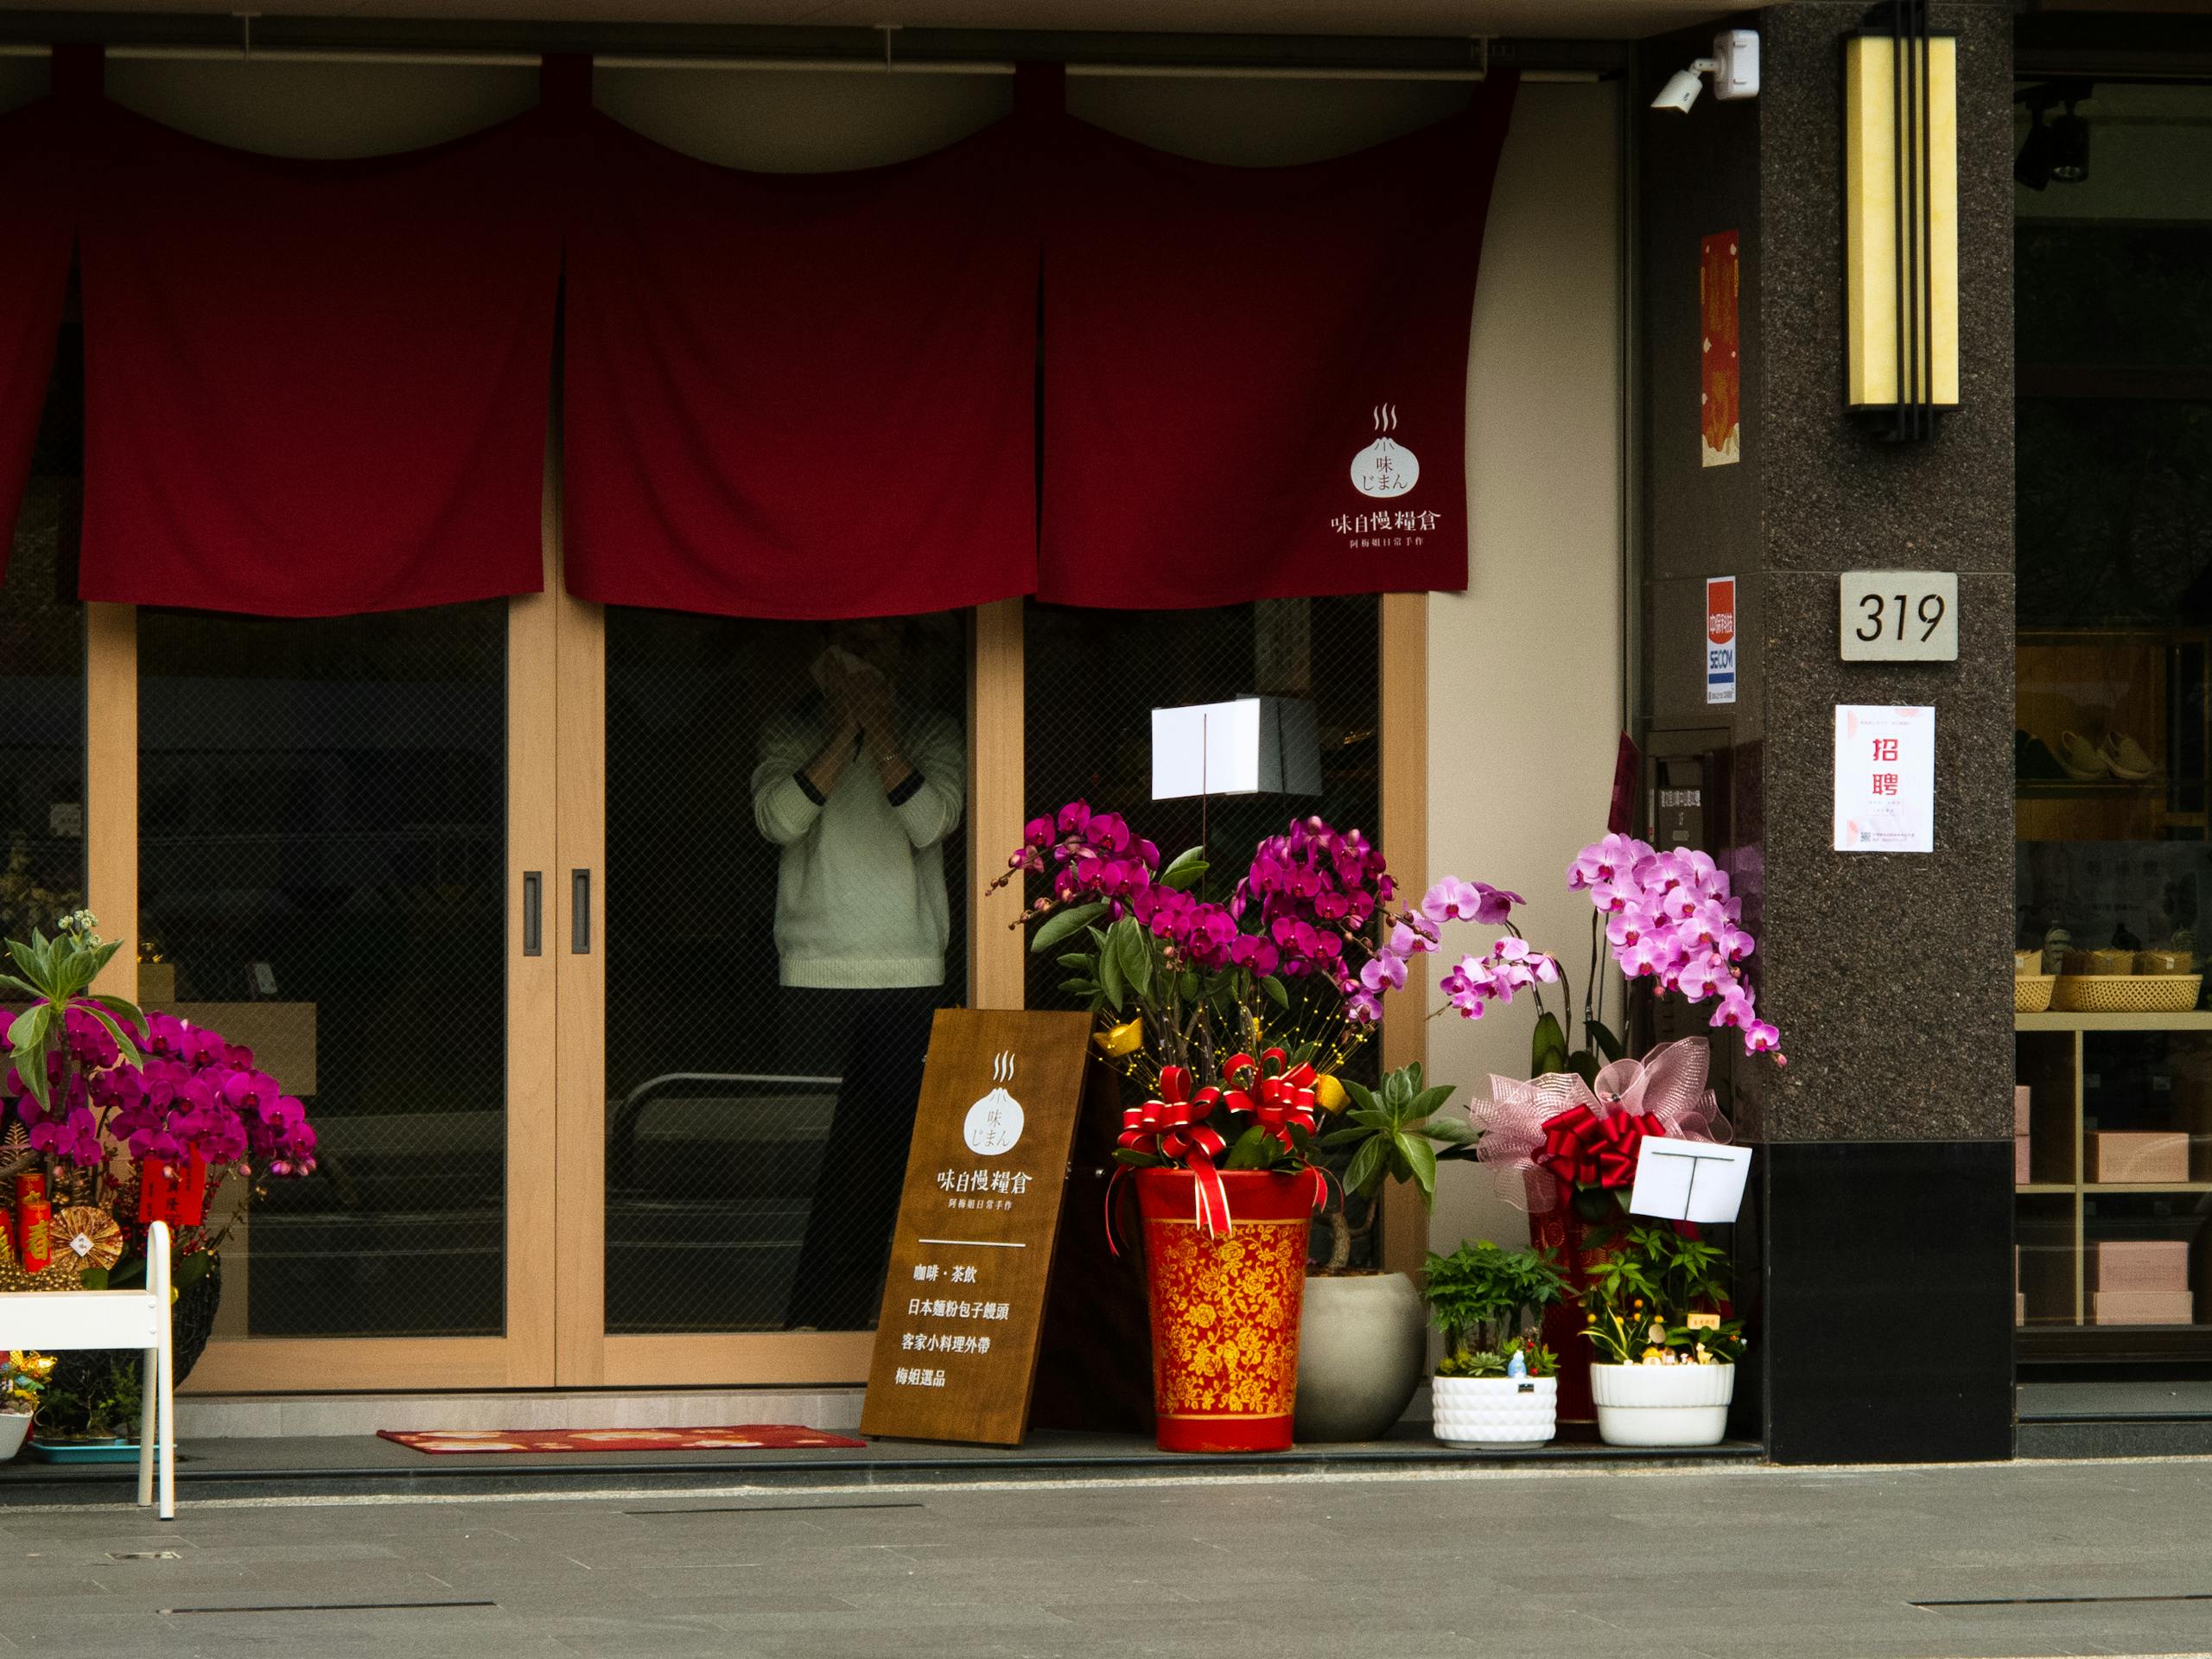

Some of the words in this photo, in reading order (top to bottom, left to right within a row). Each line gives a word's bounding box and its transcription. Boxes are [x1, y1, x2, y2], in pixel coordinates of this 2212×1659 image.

[1376, 455, 1393, 474] 味
[1363, 474, 1408, 491] じまん
[1331, 510, 1441, 534] 味自慢糧倉
[1856, 594, 1945, 642] 319
[1710, 650, 1733, 669] SECOM
[988, 1109, 1002, 1128] 味
[971, 1130, 1010, 1147] じまん
[937, 1169, 1033, 1194] 味自慢糧倉
